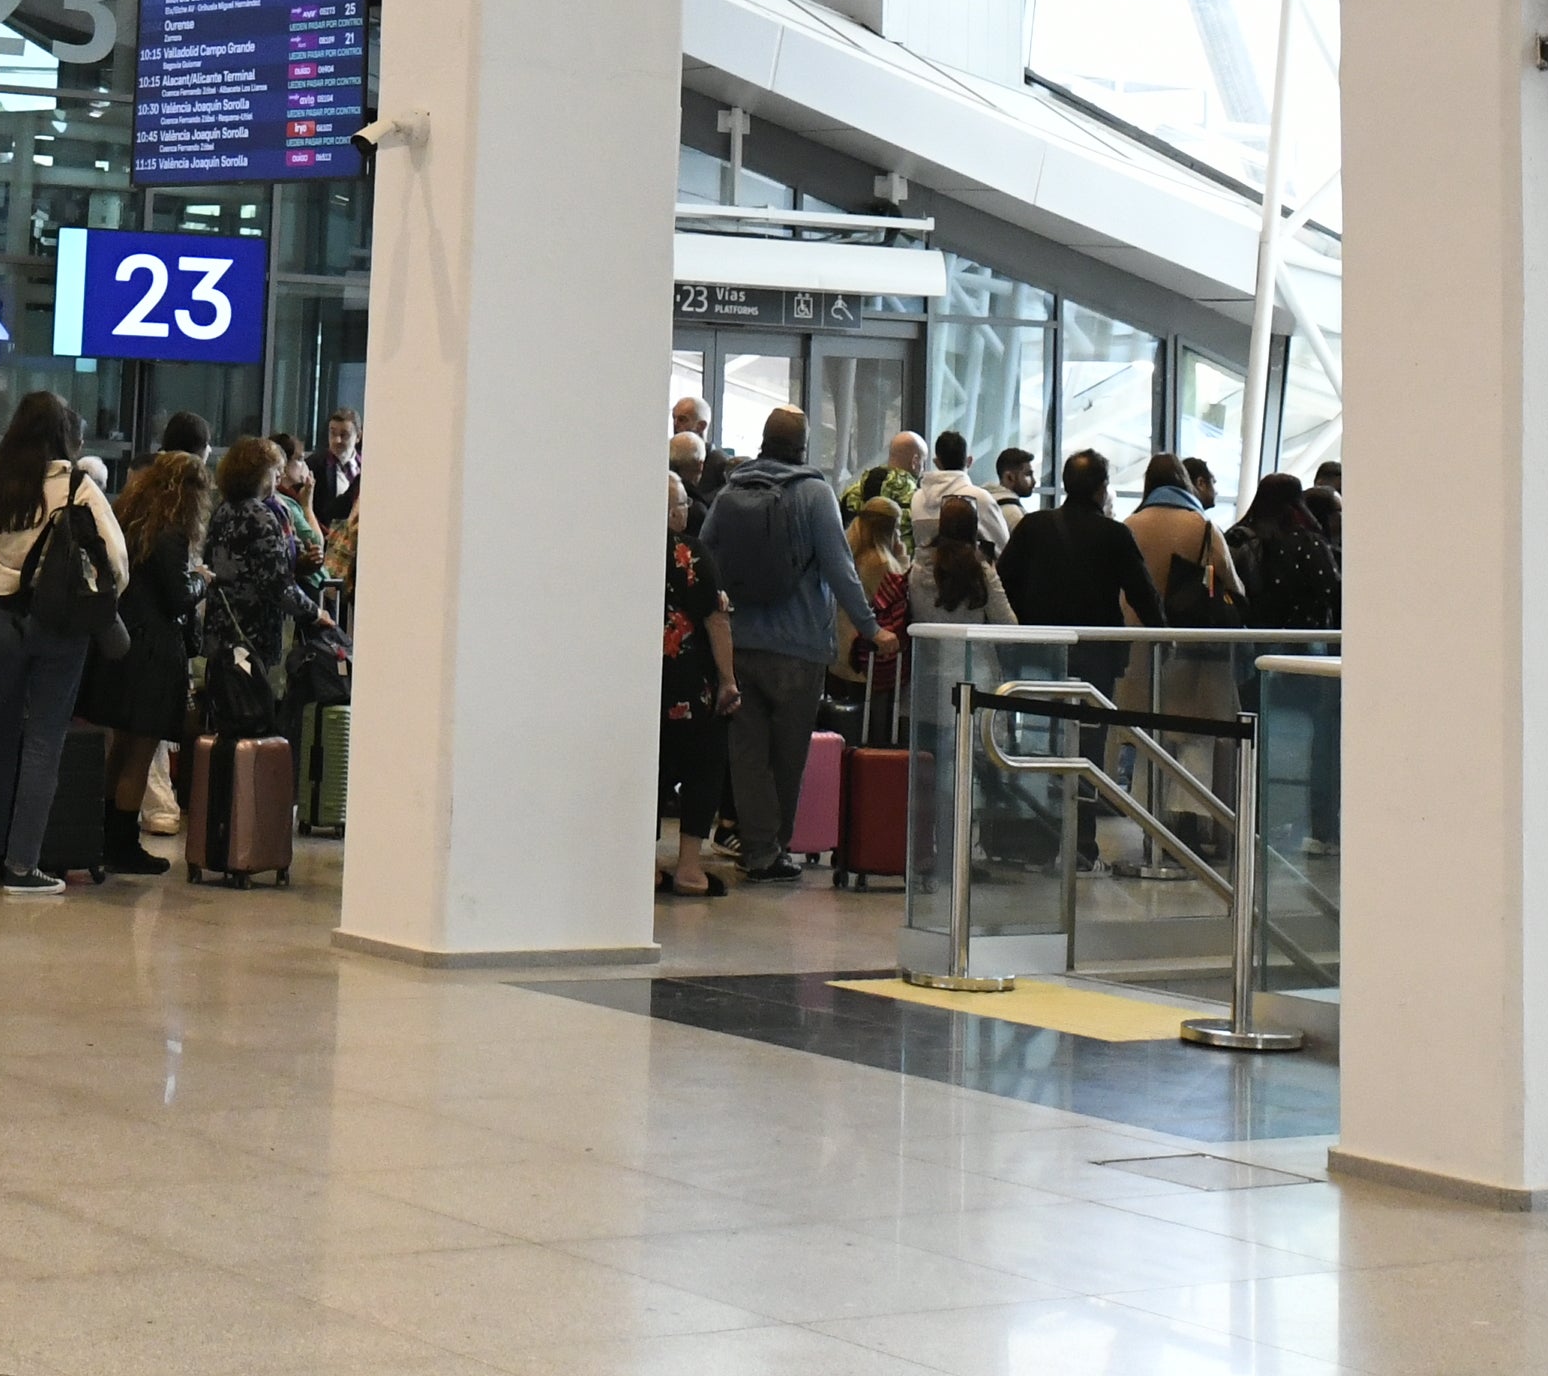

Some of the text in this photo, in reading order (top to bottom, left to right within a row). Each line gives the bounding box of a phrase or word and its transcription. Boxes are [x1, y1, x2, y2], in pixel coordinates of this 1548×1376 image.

[345, 2, 356, 16] 25
[164, 20, 195, 31] Ourense
[345, 32, 355, 45] 21
[140, 41, 255, 61] 10:15 Valladolid Campo Grande
[138, 68, 256, 88] 10:15 Alacant/Alicante Terminal
[137, 98, 250, 116] 10:30 València Joaquín Sorolla
[136, 126, 249, 143] 10:45 València Joaquín Sorolla
[135, 154, 248, 170] 11:15 València Joaquín Sorolla
[112, 253, 234, 340] 23
[716, 286, 746, 302] Vías
[714, 304, 759, 316] PLATFORMS
